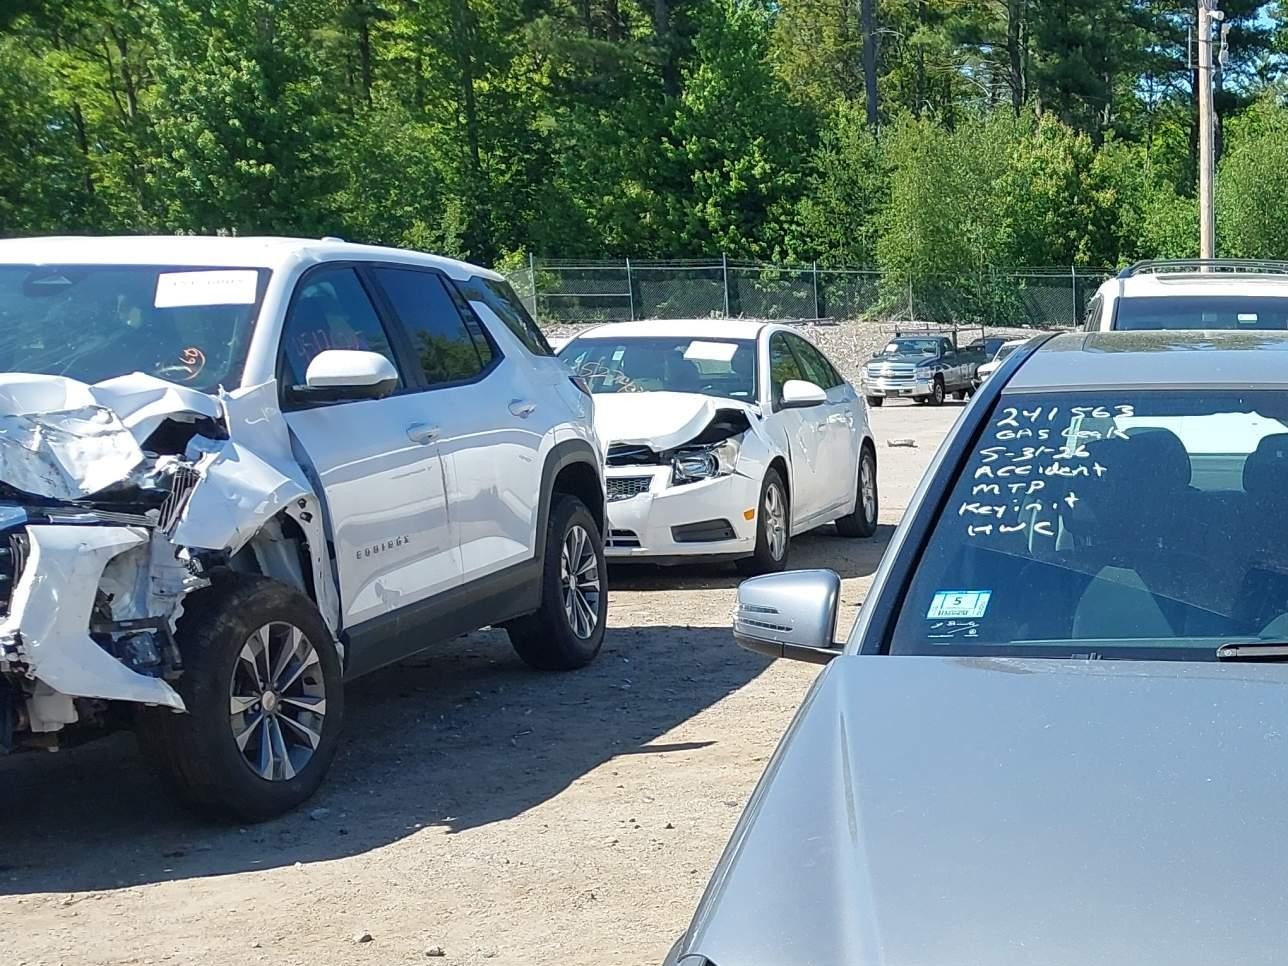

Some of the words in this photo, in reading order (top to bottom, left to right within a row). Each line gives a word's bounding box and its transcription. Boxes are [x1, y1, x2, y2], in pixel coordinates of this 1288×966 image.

[996, 407, 1059, 426] 241
[1070, 404, 1135, 419] 563
[995, 428, 1050, 440] GAS
[979, 444, 1091, 462] 5-31-26
[952, 596, 963, 606] 5
